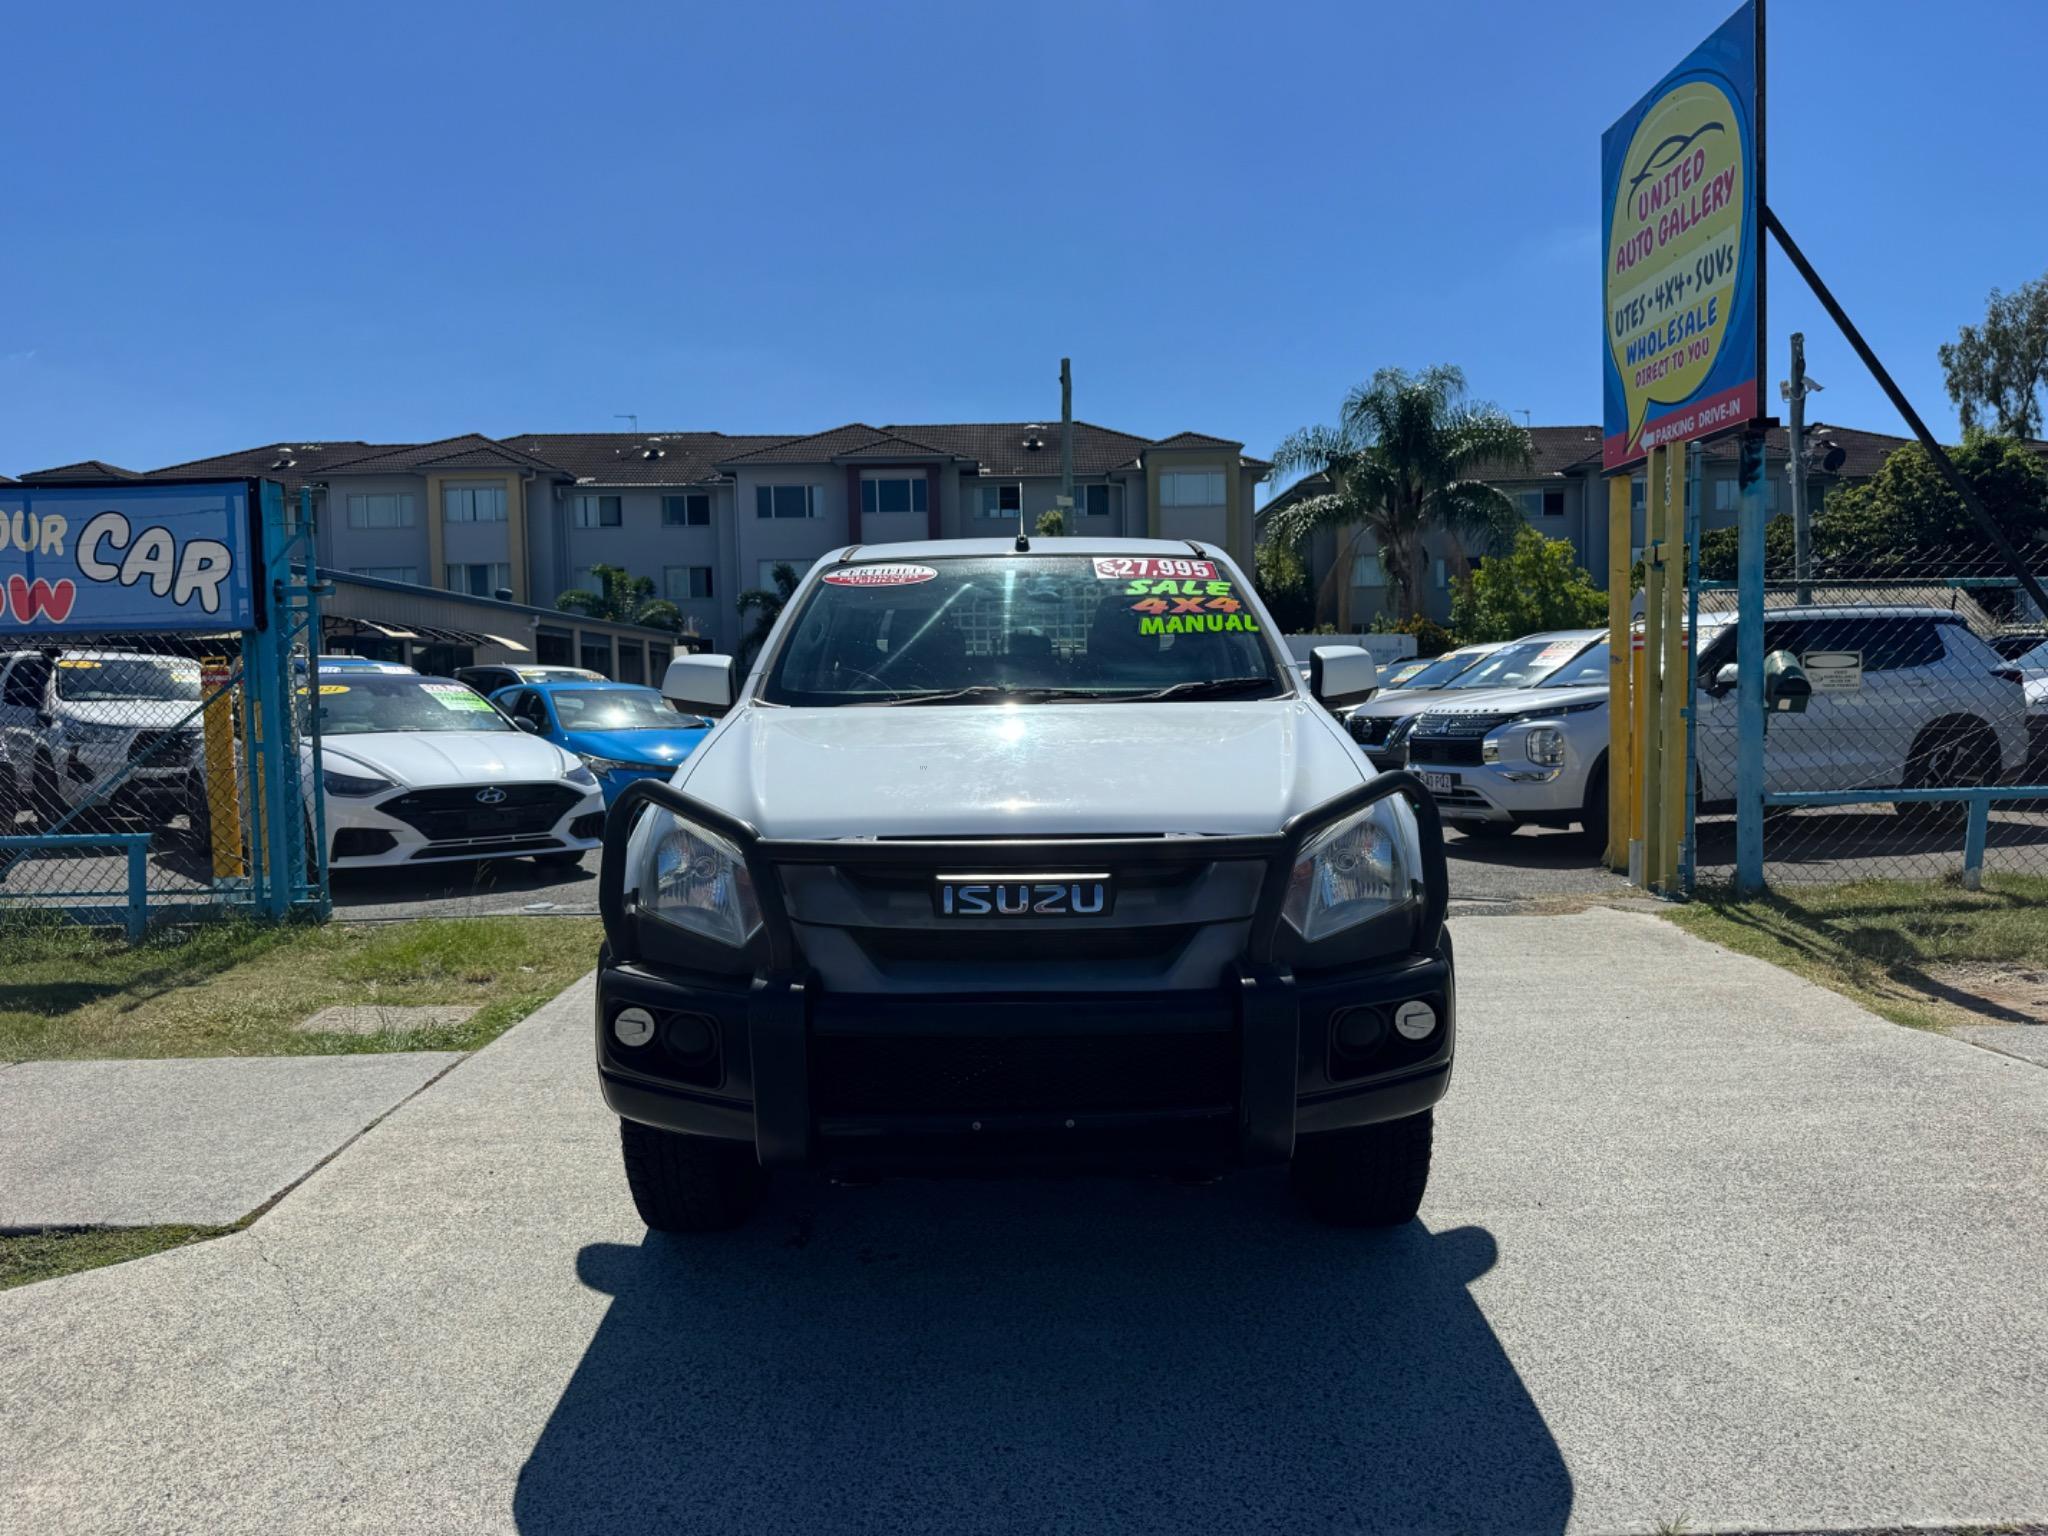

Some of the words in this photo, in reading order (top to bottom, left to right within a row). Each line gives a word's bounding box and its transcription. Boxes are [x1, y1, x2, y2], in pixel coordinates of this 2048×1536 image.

[1639, 148, 1705, 221] UNITED
[1616, 226, 1653, 275] AUTO
[1658, 164, 1735, 247] GALLERY
[1615, 293, 1645, 337] UTES
[1655, 272, 1684, 313] 4X4
[1626, 296, 1717, 367] WHOLESALE
[1635, 356, 1669, 388] DIRECT
[1672, 349, 1684, 370] TO
[1687, 337, 1709, 363] YOU
[1655, 416, 1694, 444] PARKING
[1699, 398, 1740, 428] DRIVE-IN
[75, 511, 232, 614] CAR
[1125, 579, 1232, 595] SALE
[1130, 597, 1242, 614] 4X4
[1140, 615, 1260, 635] MANUAL
[943, 884, 1104, 914] ISUZU
